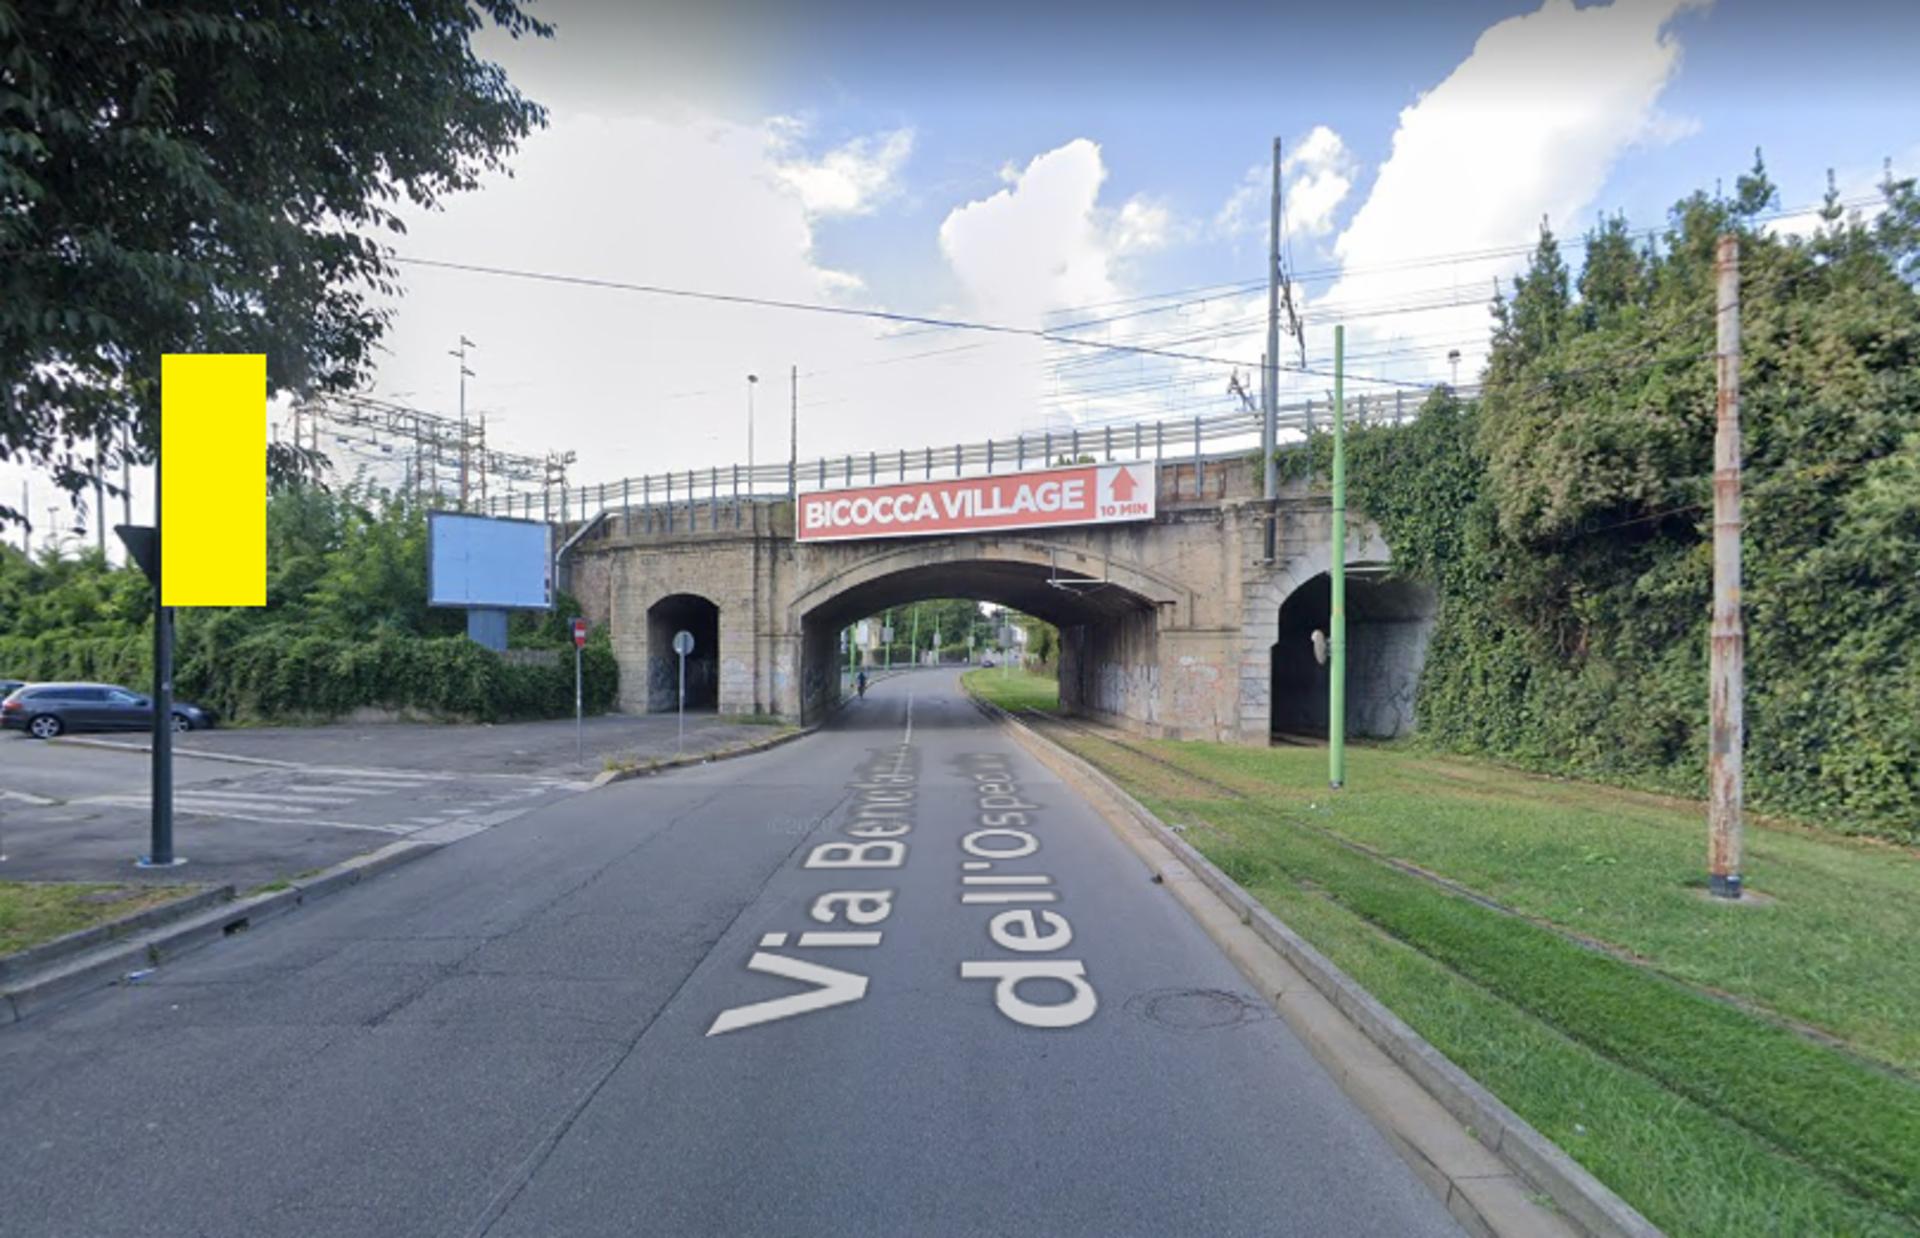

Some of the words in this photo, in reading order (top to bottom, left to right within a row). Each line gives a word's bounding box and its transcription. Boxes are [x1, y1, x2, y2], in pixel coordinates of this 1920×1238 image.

[804, 492, 941, 530] BICOCCA
[940, 479, 1086, 520] VILLAGE
[1100, 504, 1116, 518] 10
[1119, 501, 1148, 516] MIN
